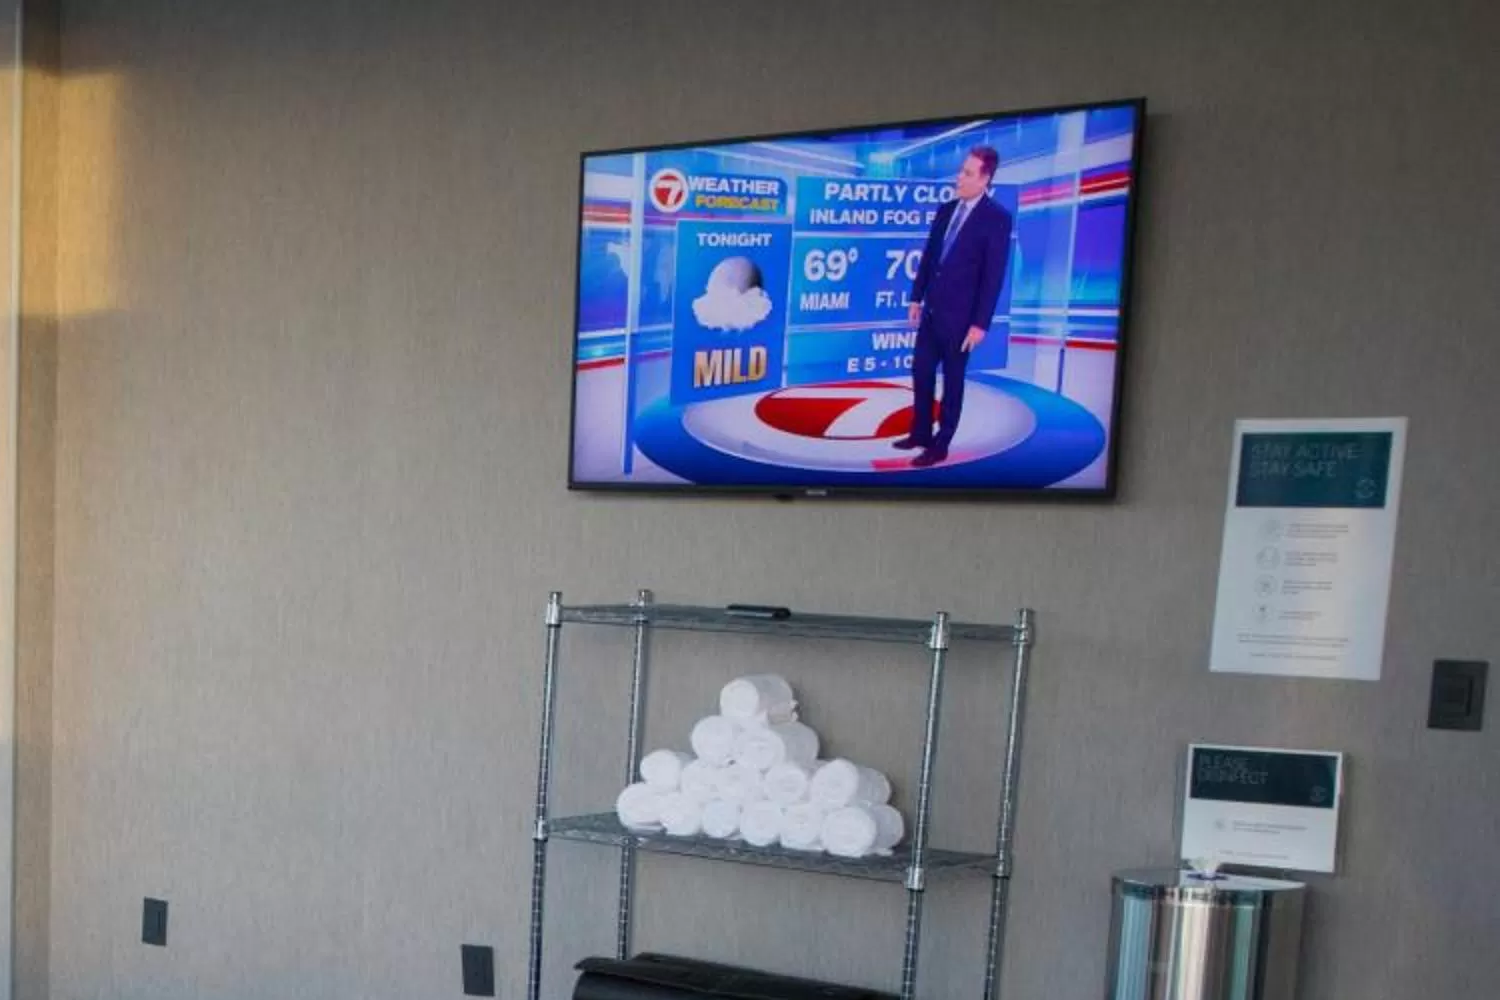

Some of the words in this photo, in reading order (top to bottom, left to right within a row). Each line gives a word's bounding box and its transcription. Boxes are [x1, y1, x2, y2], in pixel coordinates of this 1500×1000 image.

[687, 176, 779, 195] WEATHER
[824, 182, 908, 203] PARTLY
[810, 208, 879, 225] INLAND
[883, 210, 920, 225] FOG
[696, 232, 773, 248] TONIGHT
[800, 291, 850, 311] MIAMI
[694, 346, 768, 388] MILD
[846, 357, 860, 374] E
[864, 356, 877, 371] 5
